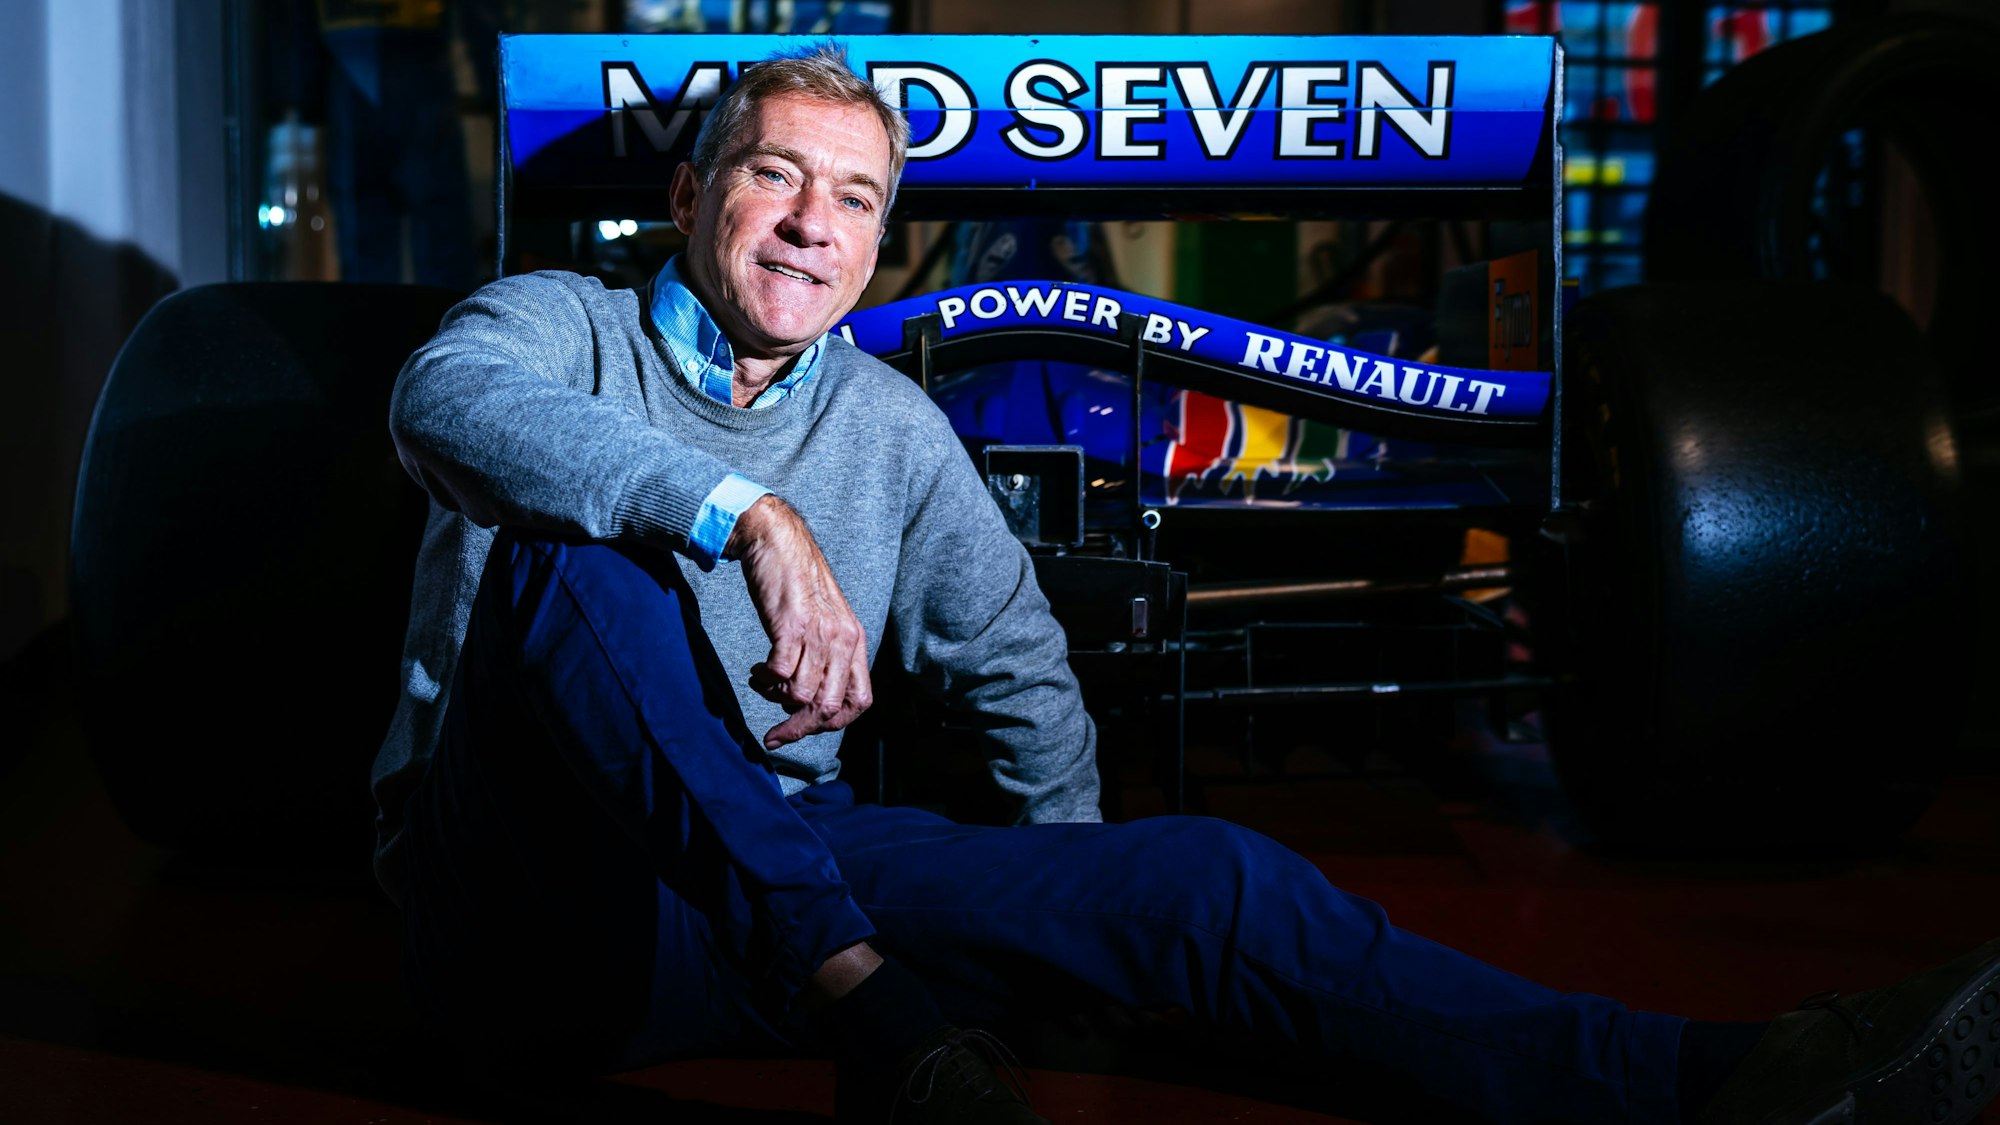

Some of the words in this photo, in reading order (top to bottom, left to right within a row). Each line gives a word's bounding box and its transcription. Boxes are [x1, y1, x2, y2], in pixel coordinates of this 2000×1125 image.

[601, 61, 977, 161] MD
[1001, 59, 1454, 160] SEVEN
[937, 286, 1122, 331] POWER
[1142, 313, 1210, 351] BY
[1238, 331, 1506, 415] RENAULT
